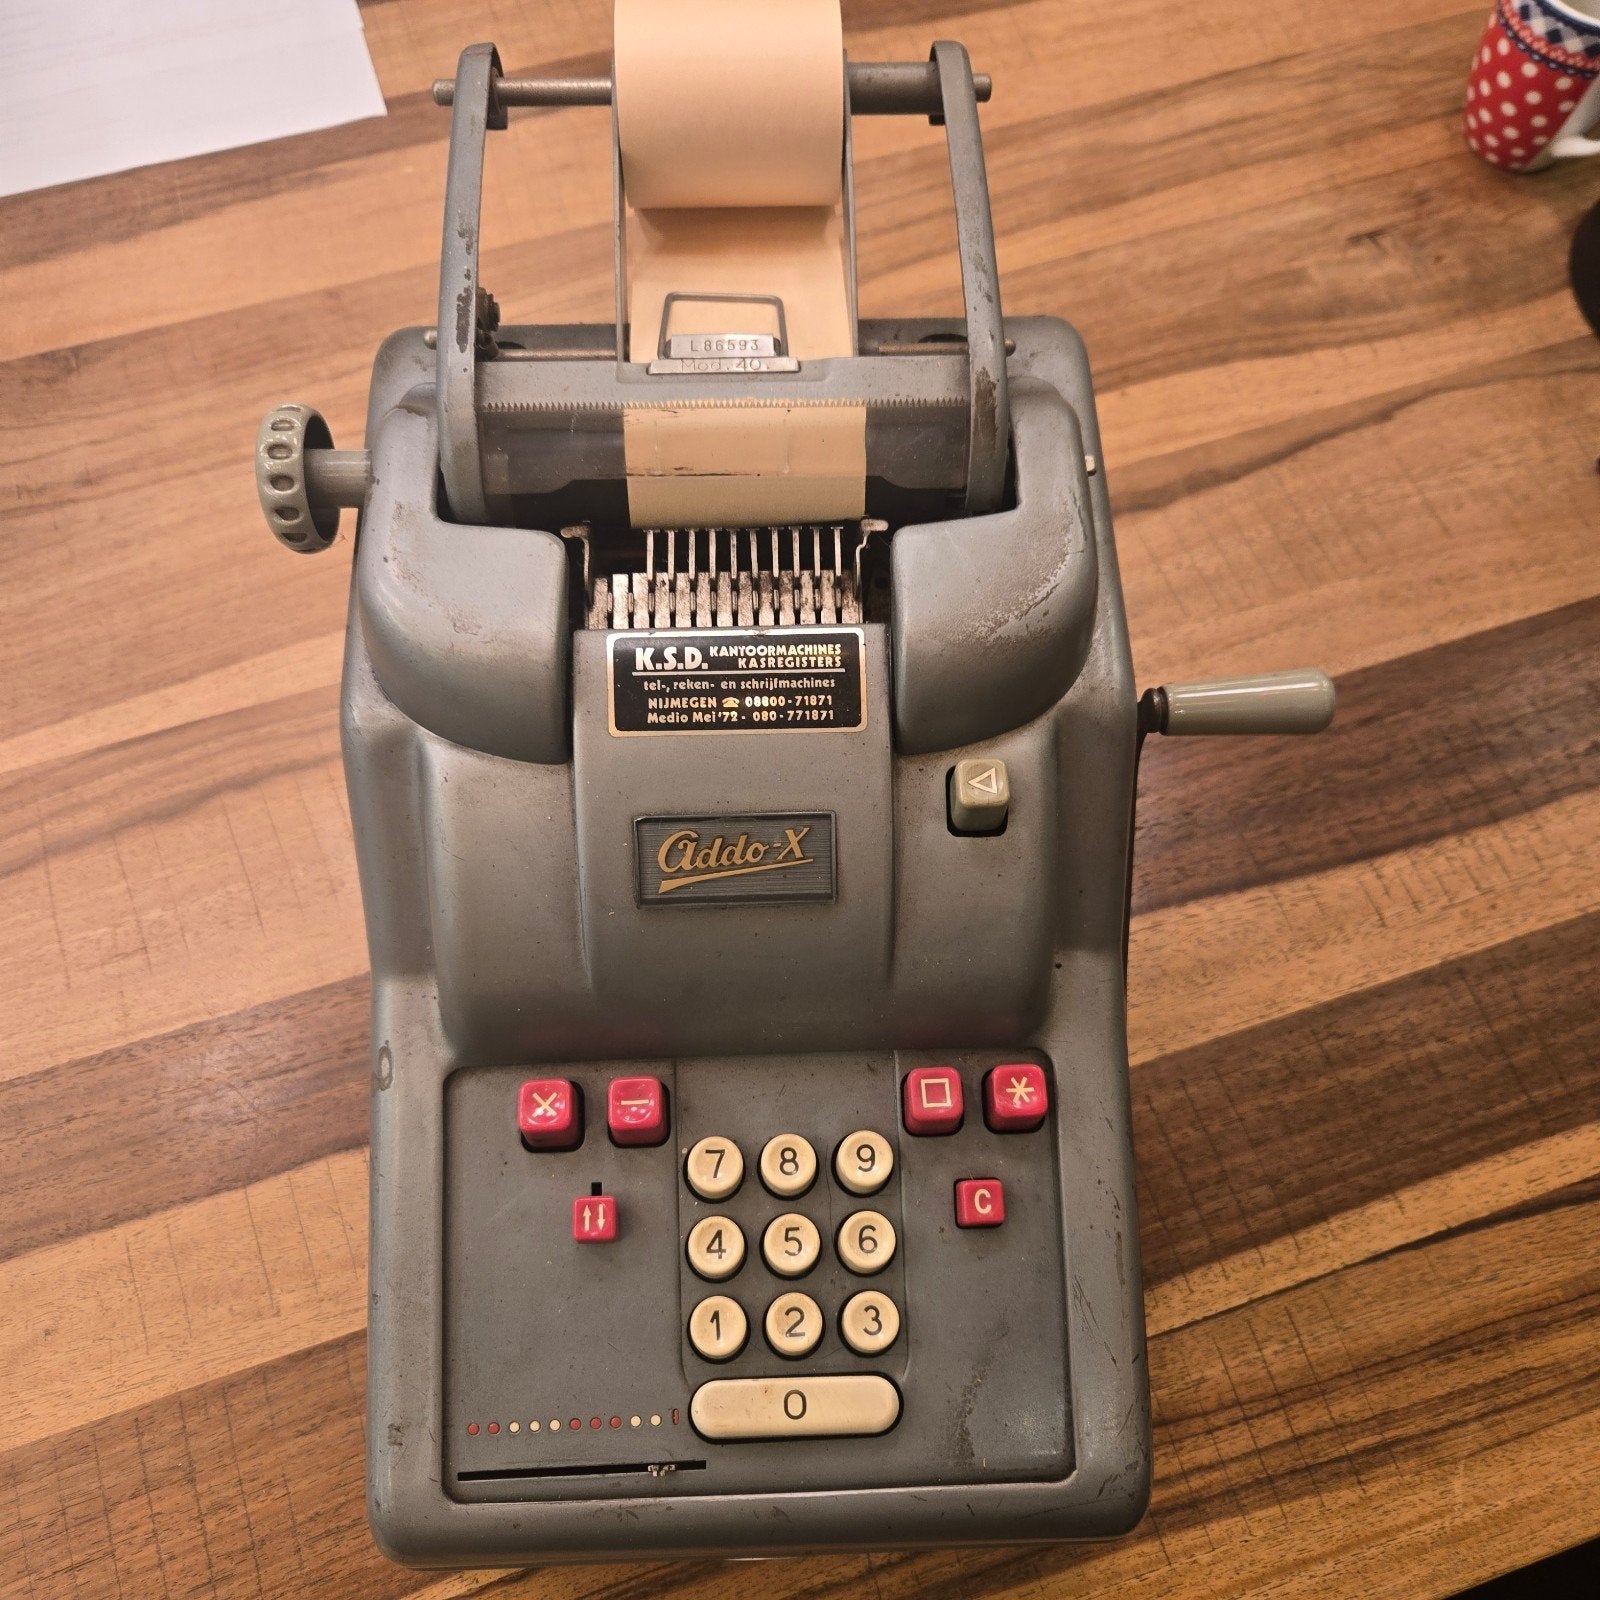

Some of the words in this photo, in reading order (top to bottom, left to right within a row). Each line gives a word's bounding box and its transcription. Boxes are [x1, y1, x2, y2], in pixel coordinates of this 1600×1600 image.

[634, 646, 709, 671] K.S.D.
[709, 643, 842, 658] KANTOORMACHINES
[738, 656, 842, 669] KASREGISTERS
[644, 679, 671, 693] tel-,
[673, 679, 715, 690] reken-
[720, 680, 736, 690] en
[740, 677, 836, 691] schrijfmachines
[648, 696, 717, 709] NIJMEGEN
[647, 711, 689, 724] Medio
[692, 711, 716, 722] Mei
[704, 1149, 726, 1179] 7
[779, 1147, 800, 1176] 8
[855, 1143, 876, 1172] 9
[974, 1188, 992, 1214] C
[706, 1229, 727, 1260] 4
[784, 1226, 803, 1257] 5
[858, 1224, 878, 1254] 6
[709, 1309, 721, 1341] 1
[784, 1306, 806, 1338] 2
[862, 1304, 883, 1336] 3
[783, 1389, 807, 1420] 0
